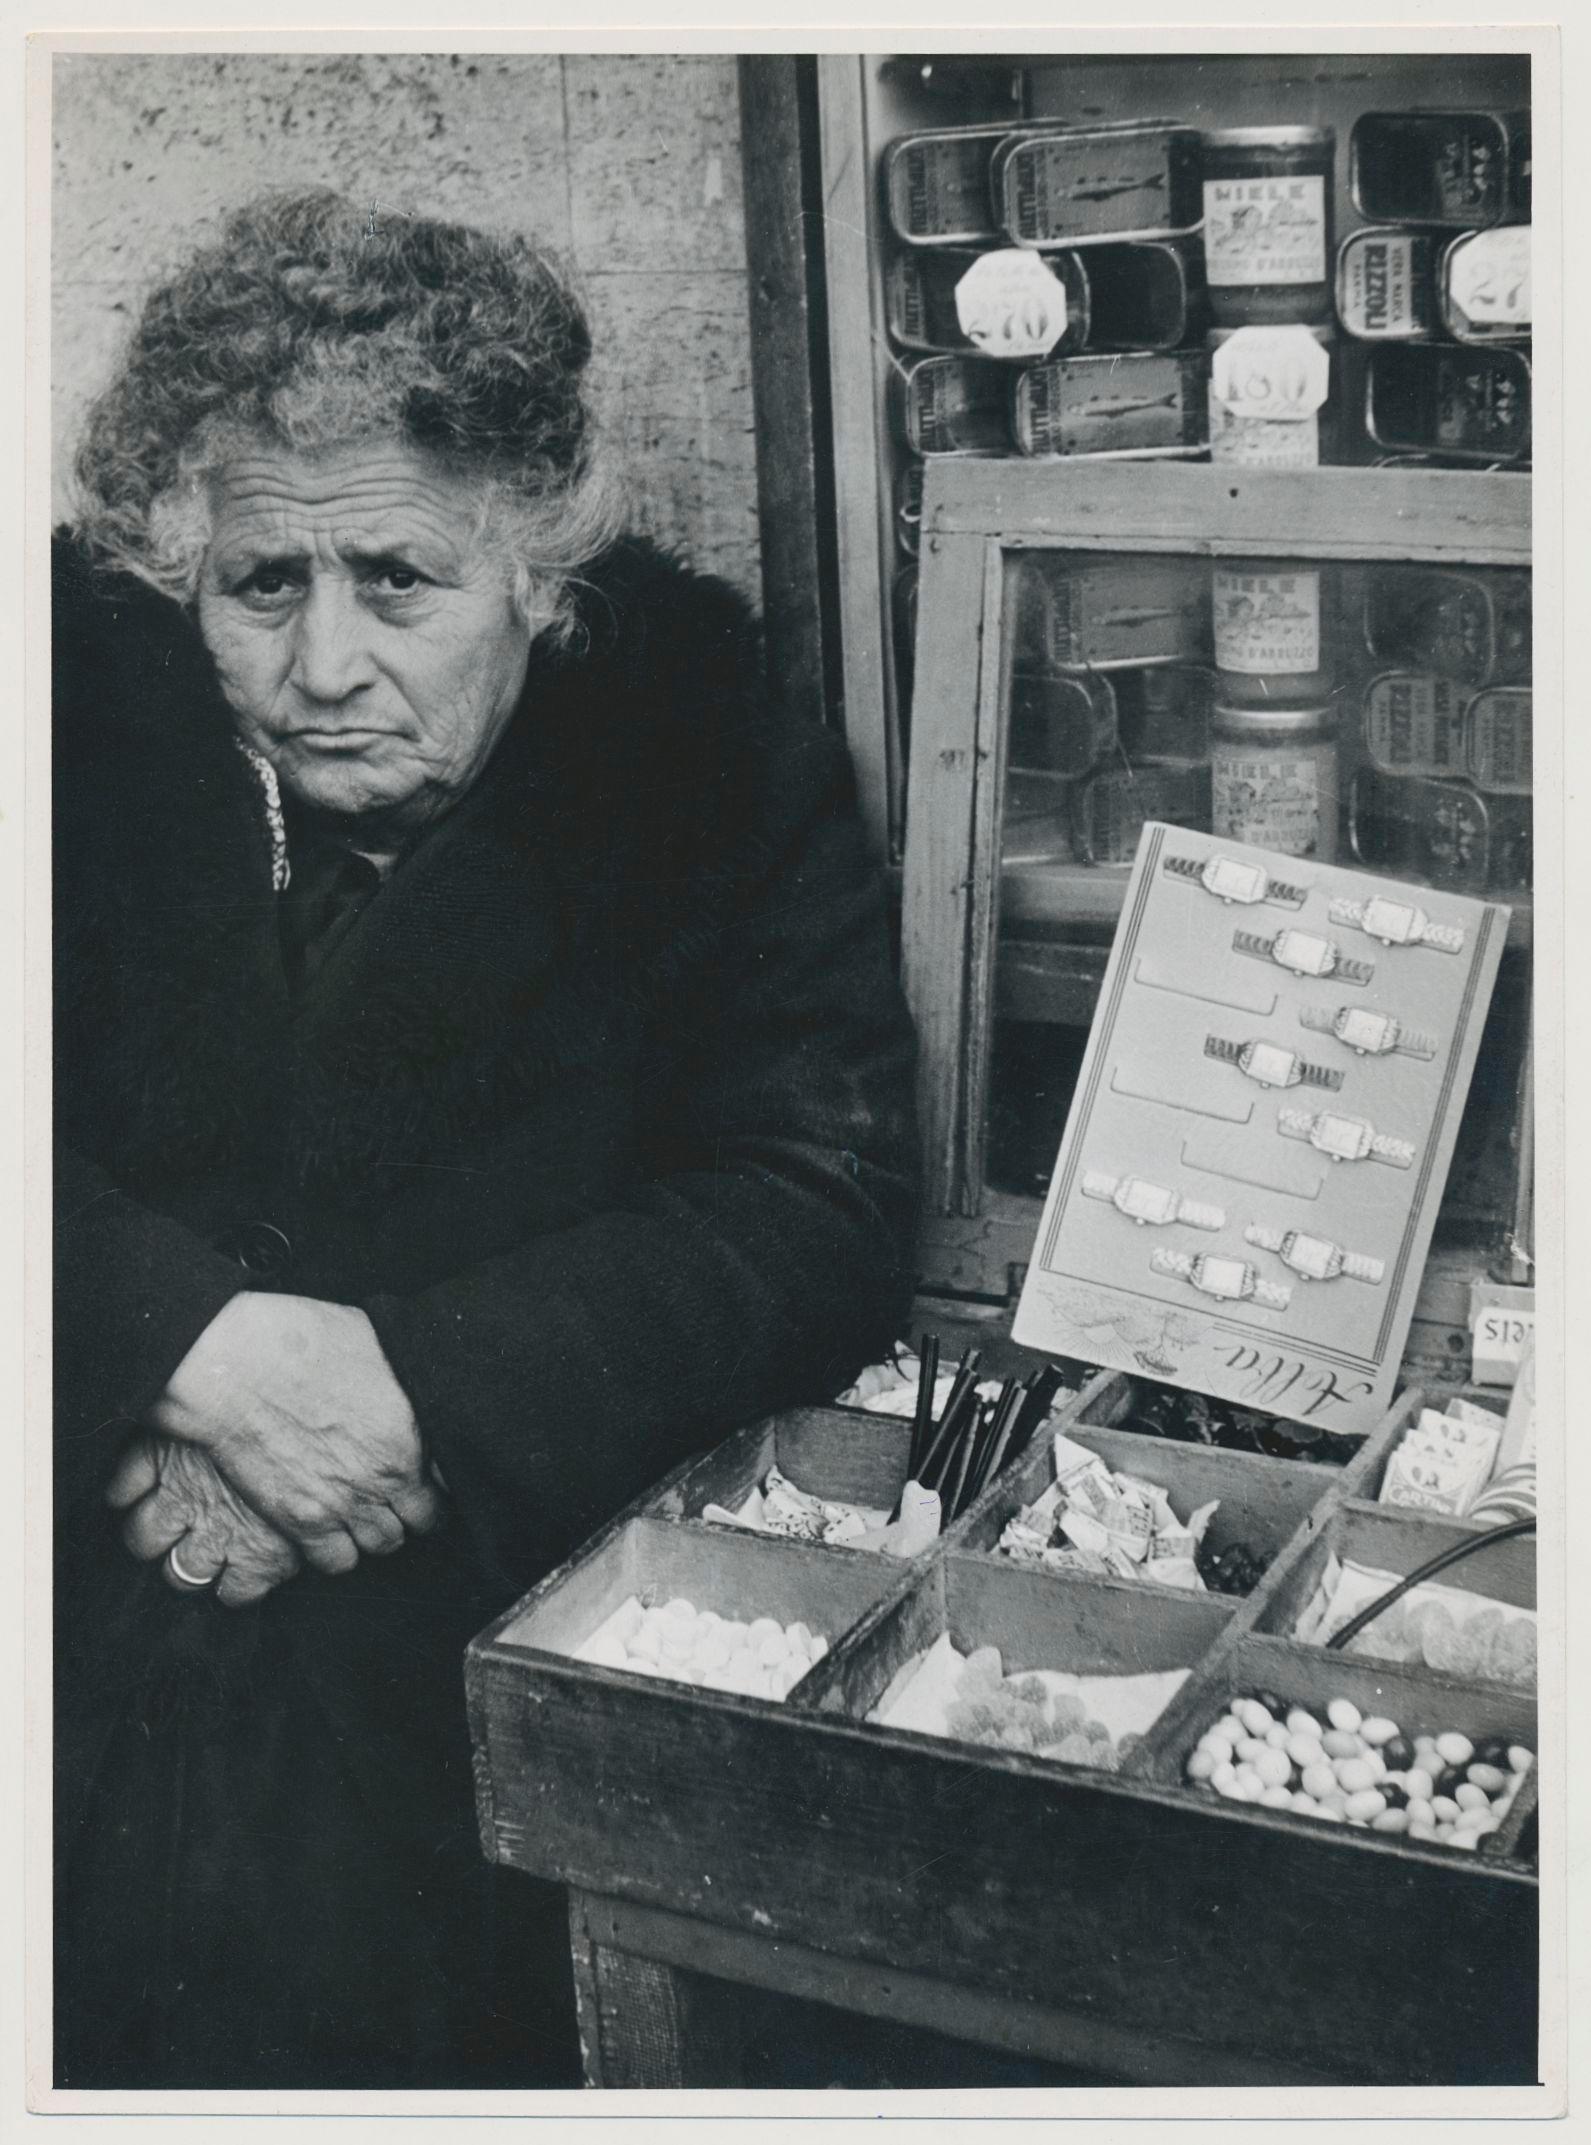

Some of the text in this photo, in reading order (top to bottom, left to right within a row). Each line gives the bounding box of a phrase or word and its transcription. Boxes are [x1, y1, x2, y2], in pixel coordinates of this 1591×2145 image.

[1214, 184, 1305, 202] MIELE
[1365, 244, 1388, 330] RIZZOLI
[1217, 576, 1296, 594] MIELE
